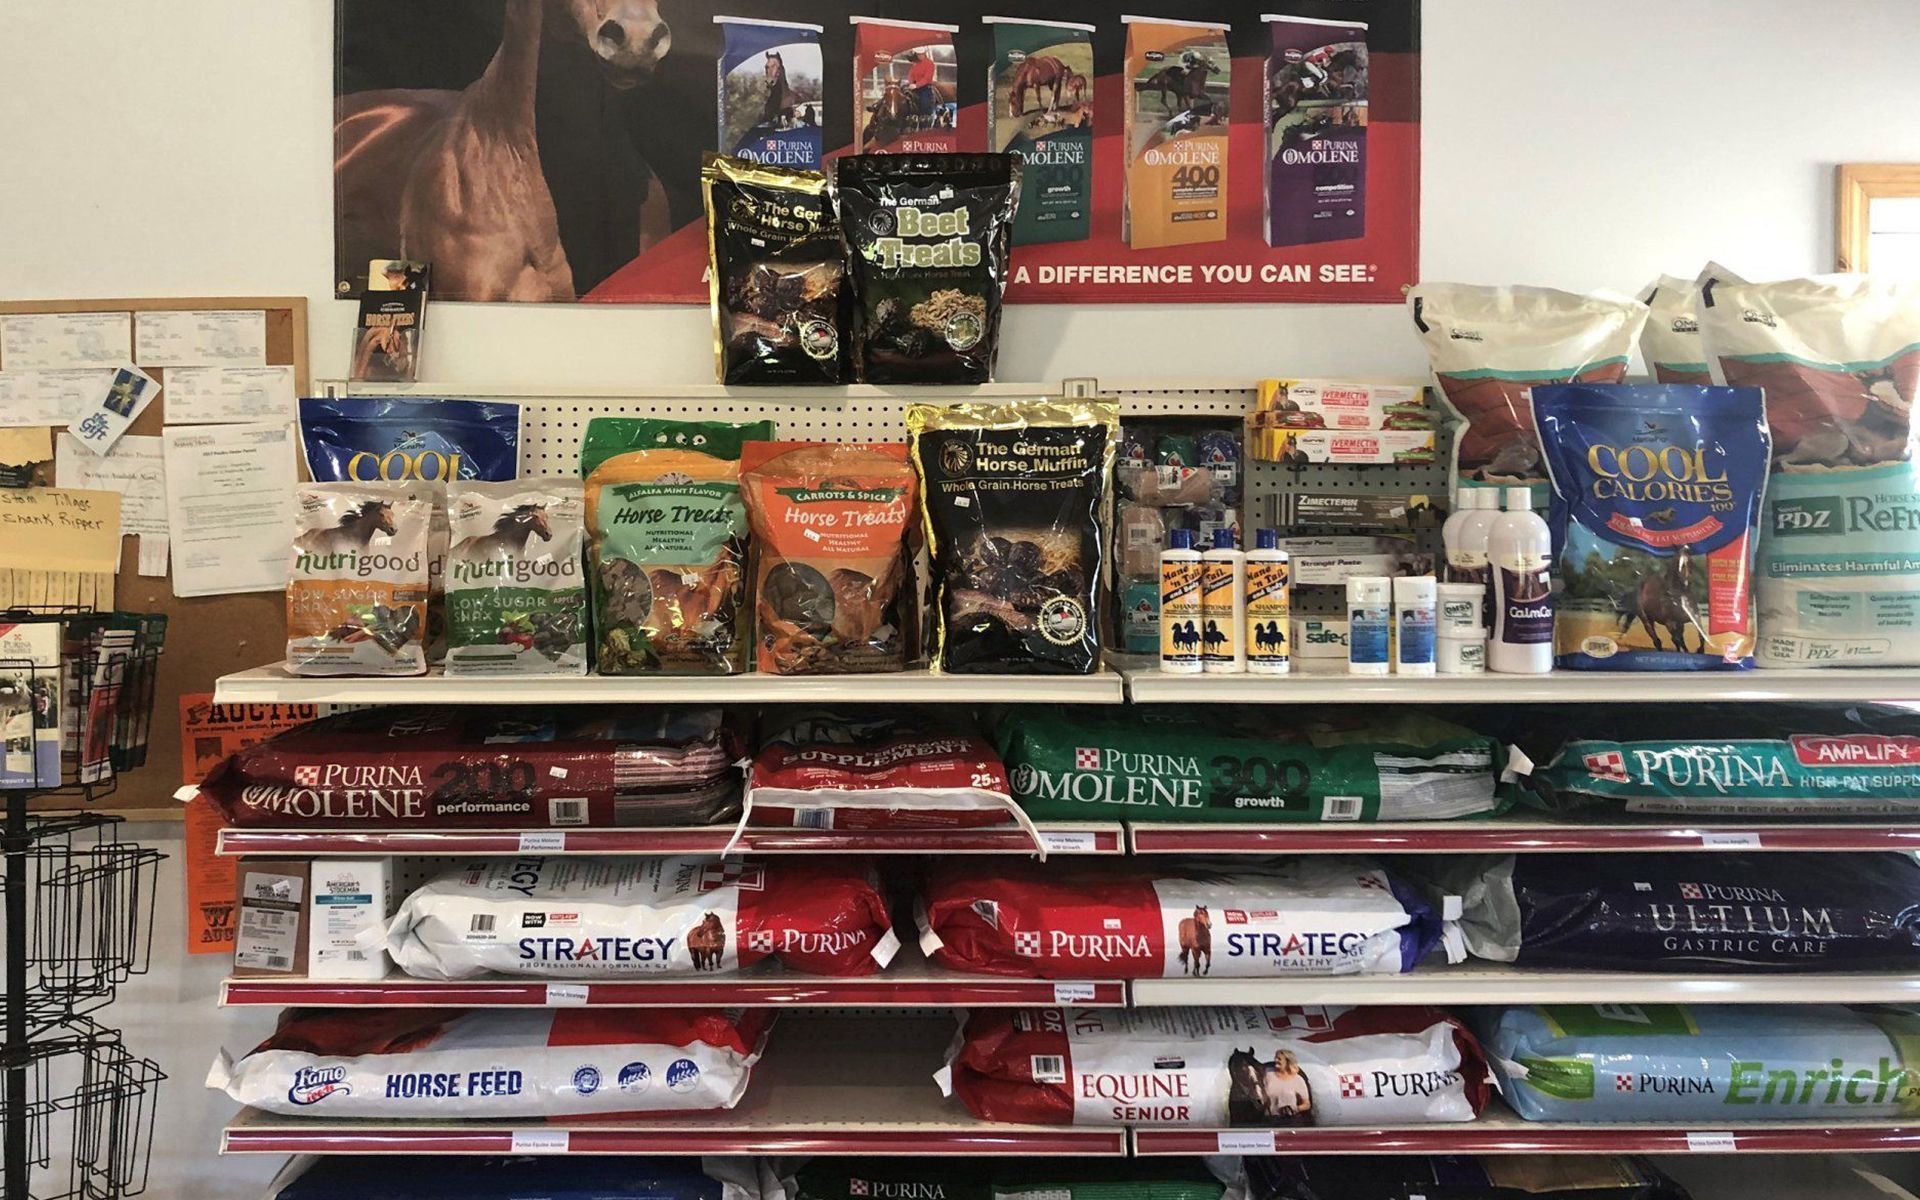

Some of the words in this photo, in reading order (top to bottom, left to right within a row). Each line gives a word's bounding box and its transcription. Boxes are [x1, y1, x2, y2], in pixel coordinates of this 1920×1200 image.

[777, 139, 813, 151] PURINA
[911, 140, 948, 151] PURINA
[1047, 140, 1083, 151] PURINA
[1184, 140, 1219, 152] PURINA
[1323, 139, 1358, 150] PURINA
[738, 149, 814, 165] OMOLENE
[1144, 149, 1220, 166] OMOLENE
[1282, 148, 1359, 165] OMOLENE
[1171, 165, 1220, 187] 400
[763, 200, 789, 217] The
[880, 197, 897, 207] The
[899, 194, 940, 206] German
[761, 214, 804, 231] Horse
[895, 206, 970, 237] Beet
[727, 221, 757, 235] Whole
[759, 230, 787, 242] Grain
[876, 237, 981, 269] Treats
[1014, 266, 1031, 283] A
[1038, 265, 1193, 284] DIFFERENCE
[1200, 265, 1252, 283] YOU
[1260, 264, 1311, 283] CAN
[1322, 389, 1369, 401] IVERMECTIN
[975, 441, 1008, 456] The
[1012, 441, 1082, 457] German
[1330, 438, 1379, 448] IVERMECTIN
[975, 457, 1028, 473] Horse
[1033, 456, 1088, 473] Muffin
[1587, 444, 1728, 484] COOL
[628, 487, 662, 499] ALFALFA
[663, 486, 687, 494] MINT
[688, 487, 722, 498] FLAVOR
[942, 481, 975, 493] Whole
[978, 479, 1010, 491] Grain
[1013, 480, 1047, 491] Horse
[1049, 477, 1085, 490] Treats
[1592, 478, 1733, 503] CALORIES
[796, 491, 844, 502] CARROTS
[847, 491, 856, 500] &
[858, 491, 888, 501] SPICE
[1297, 495, 1359, 507] ZIMECTERIN
[58, 511, 104, 531] Ripper
[613, 507, 666, 525] Horse
[670, 505, 735, 525] Treats
[784, 506, 839, 527] Horse
[841, 506, 905, 528] Treats
[1776, 510, 1832, 530] PDZ
[645, 529, 694, 537] NUTRITIONAL
[820, 532, 869, 540] NUTRITIONAL
[661, 544, 693, 552] NATURAL
[828, 539, 862, 547] HEALTHY
[839, 545, 870, 553] NATURAL
[295, 550, 420, 577] nutrigood
[454, 555, 576, 584] nutrigood
[1771, 561, 1842, 574] Eliminates
[1845, 559, 1900, 573] Harmful
[1163, 565, 1189, 582] Mane
[1182, 567, 1200, 584] Tail
[1265, 568, 1285, 585] Tail
[454, 610, 493, 623] SNAX
[1772, 637, 1796, 647] MADE
[1806, 648, 1839, 660] PDZ
[207, 703, 318, 724] AUCTIO
[782, 742, 973, 768] SUPPLEMENT
[1818, 743, 1910, 763] AMPLIFY
[1105, 747, 1202, 777] PURINA
[322, 763, 424, 788] PURINA
[1208, 754, 1312, 795] 300
[1632, 748, 1793, 794] PURINA
[430, 760, 537, 800] 200
[1009, 763, 1203, 809] OMOLENE
[241, 782, 427, 819] OMOLENE
[437, 800, 530, 816] performance
[1234, 795, 1285, 810] growth
[1720, 804, 1735, 812] FOR
[1737, 804, 1768, 813] WEIGHT
[1704, 882, 1786, 903] PURINA
[1648, 902, 1837, 935] ULTIUM
[519, 937, 676, 961] STRATEGY
[783, 927, 867, 954] PURINA
[1049, 930, 1152, 961] PURINA
[1664, 936, 1760, 952] GASTRIC
[1772, 938, 1828, 954] CARE
[519, 961, 597, 969] PROFESSIONAL
[1273, 958, 1333, 967] HEALTHY
[676, 1061, 688, 1069] FCI
[300, 1065, 346, 1088] Famo
[385, 1073, 461, 1098] HORSE
[468, 1070, 523, 1097] FEED
[1639, 1072, 1715, 1097] PURINA
[1723, 1058, 1909, 1105] Enrich
[1082, 1073, 1190, 1105] EQUINE
[1112, 1106, 1190, 1121] SENIOR
[873, 1181, 946, 1200] PURINA
